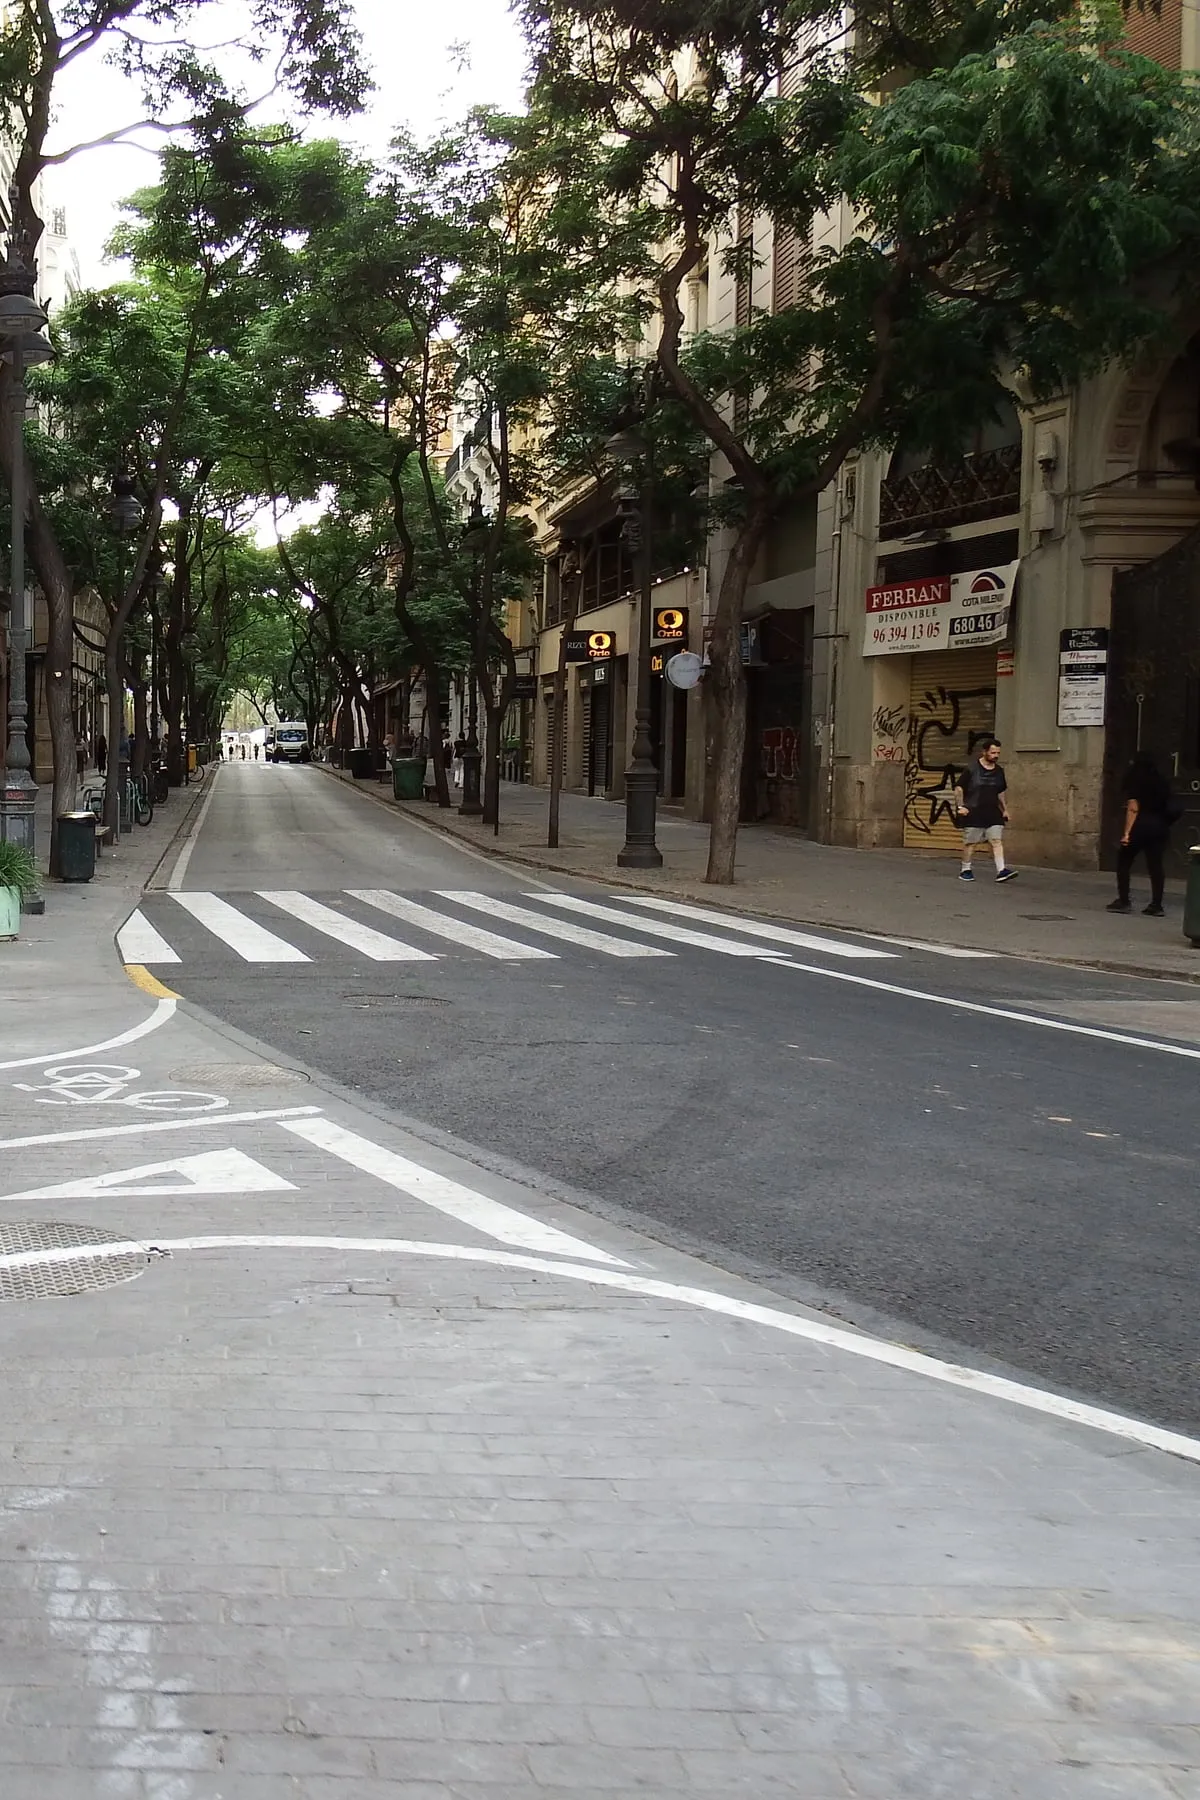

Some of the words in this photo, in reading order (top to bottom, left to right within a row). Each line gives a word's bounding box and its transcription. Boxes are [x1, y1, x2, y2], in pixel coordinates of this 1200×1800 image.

[871, 583, 943, 609] FERRAN
[878, 606, 938, 623] DISPONIBLE
[954, 617, 975, 634] 680
[977, 615, 993, 631] 46
[873, 628, 886, 644] 96
[887, 625, 907, 643] 394
[911, 623, 924, 640] 13
[926, 621, 941, 639] 05
